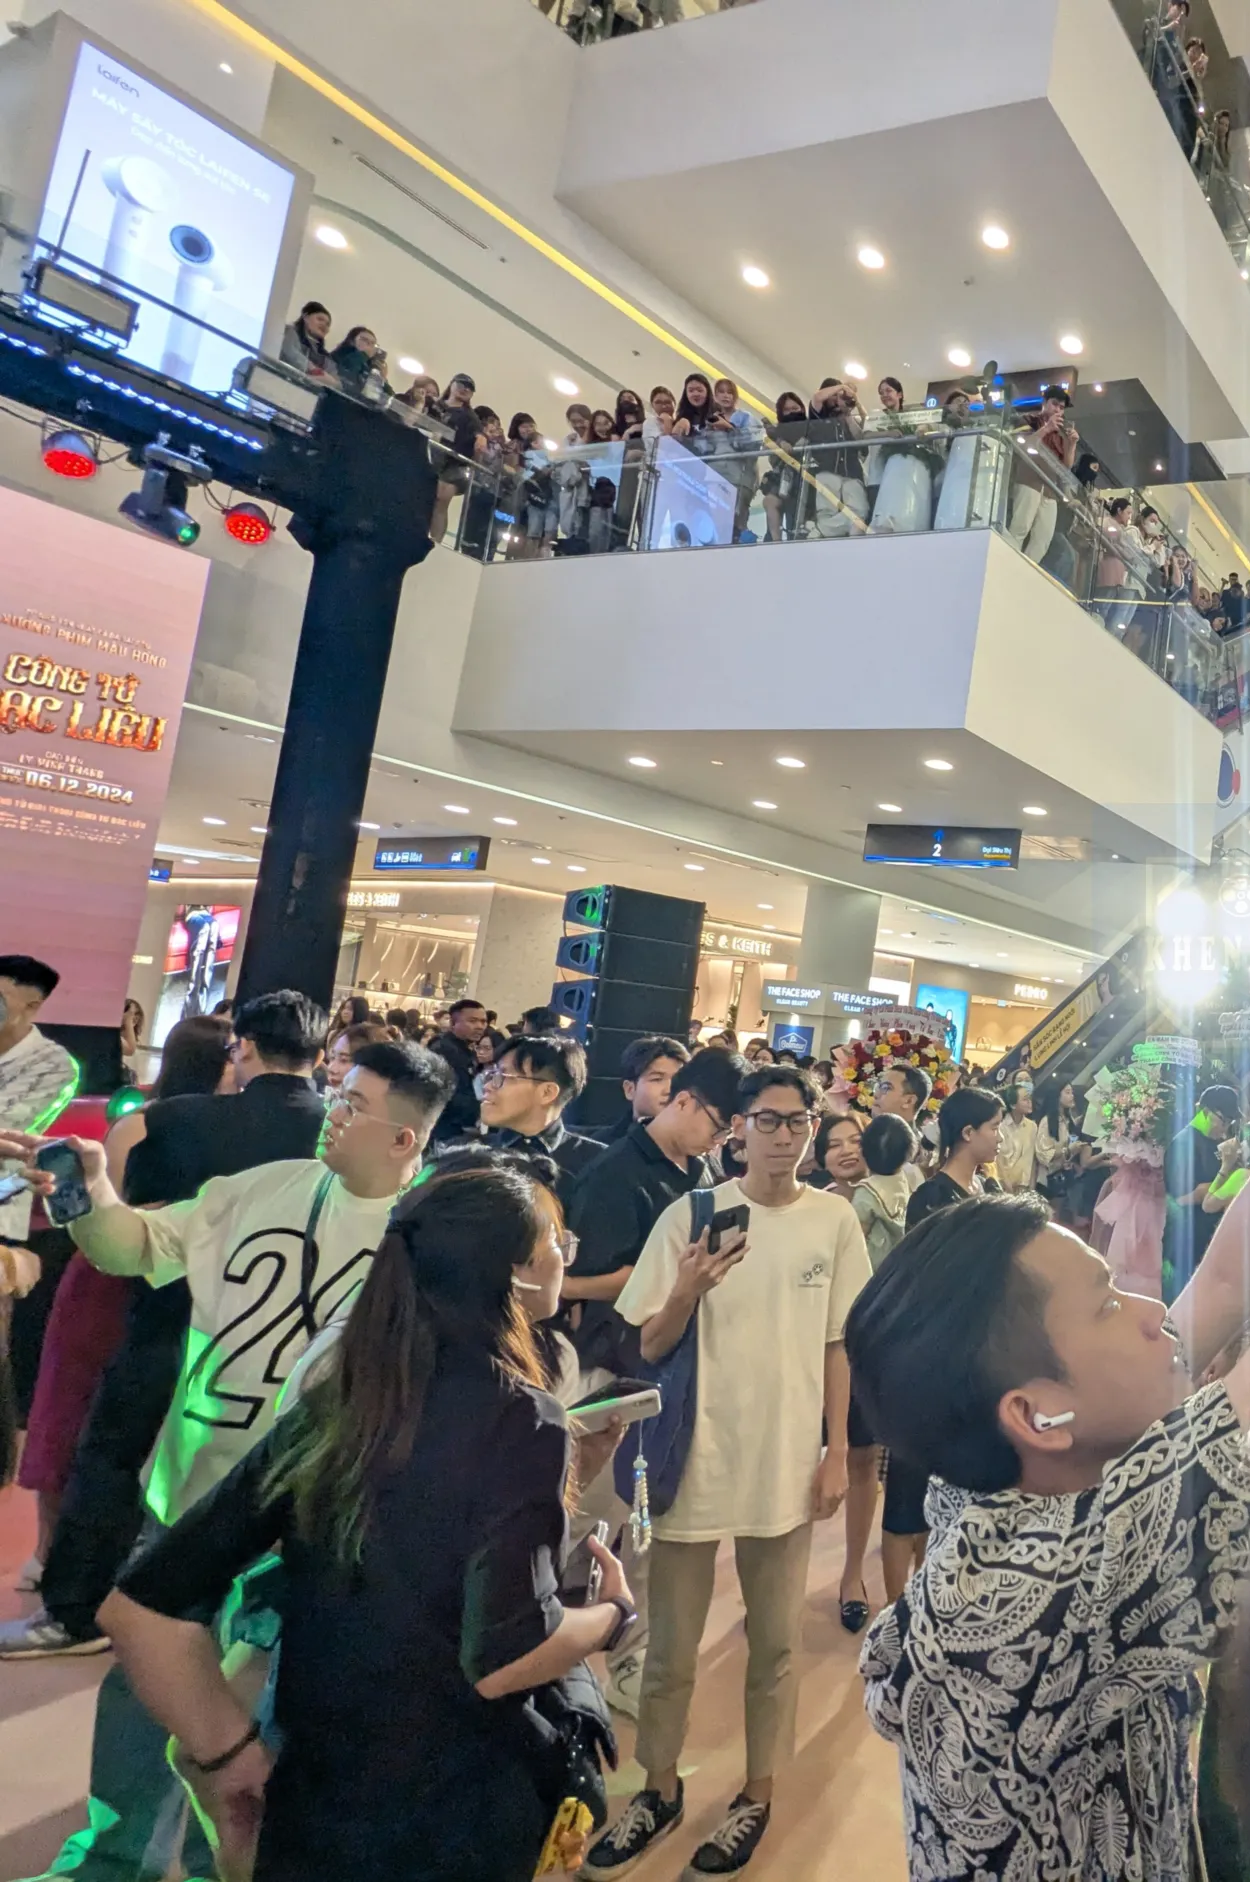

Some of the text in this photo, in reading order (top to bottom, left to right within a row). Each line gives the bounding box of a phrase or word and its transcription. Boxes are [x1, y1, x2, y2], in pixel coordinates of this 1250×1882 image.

[55, 627, 93, 648] PHIM
[24, 770, 134, 806] 06.12.2024
[932, 843, 942, 857] 2
[718, 935, 728, 949] &
[731, 936, 772, 957] KEITH
[767, 986, 821, 999] THE FACE SHOP
[833, 991, 850, 1002] THE
[850, 994, 871, 1005] FACE
